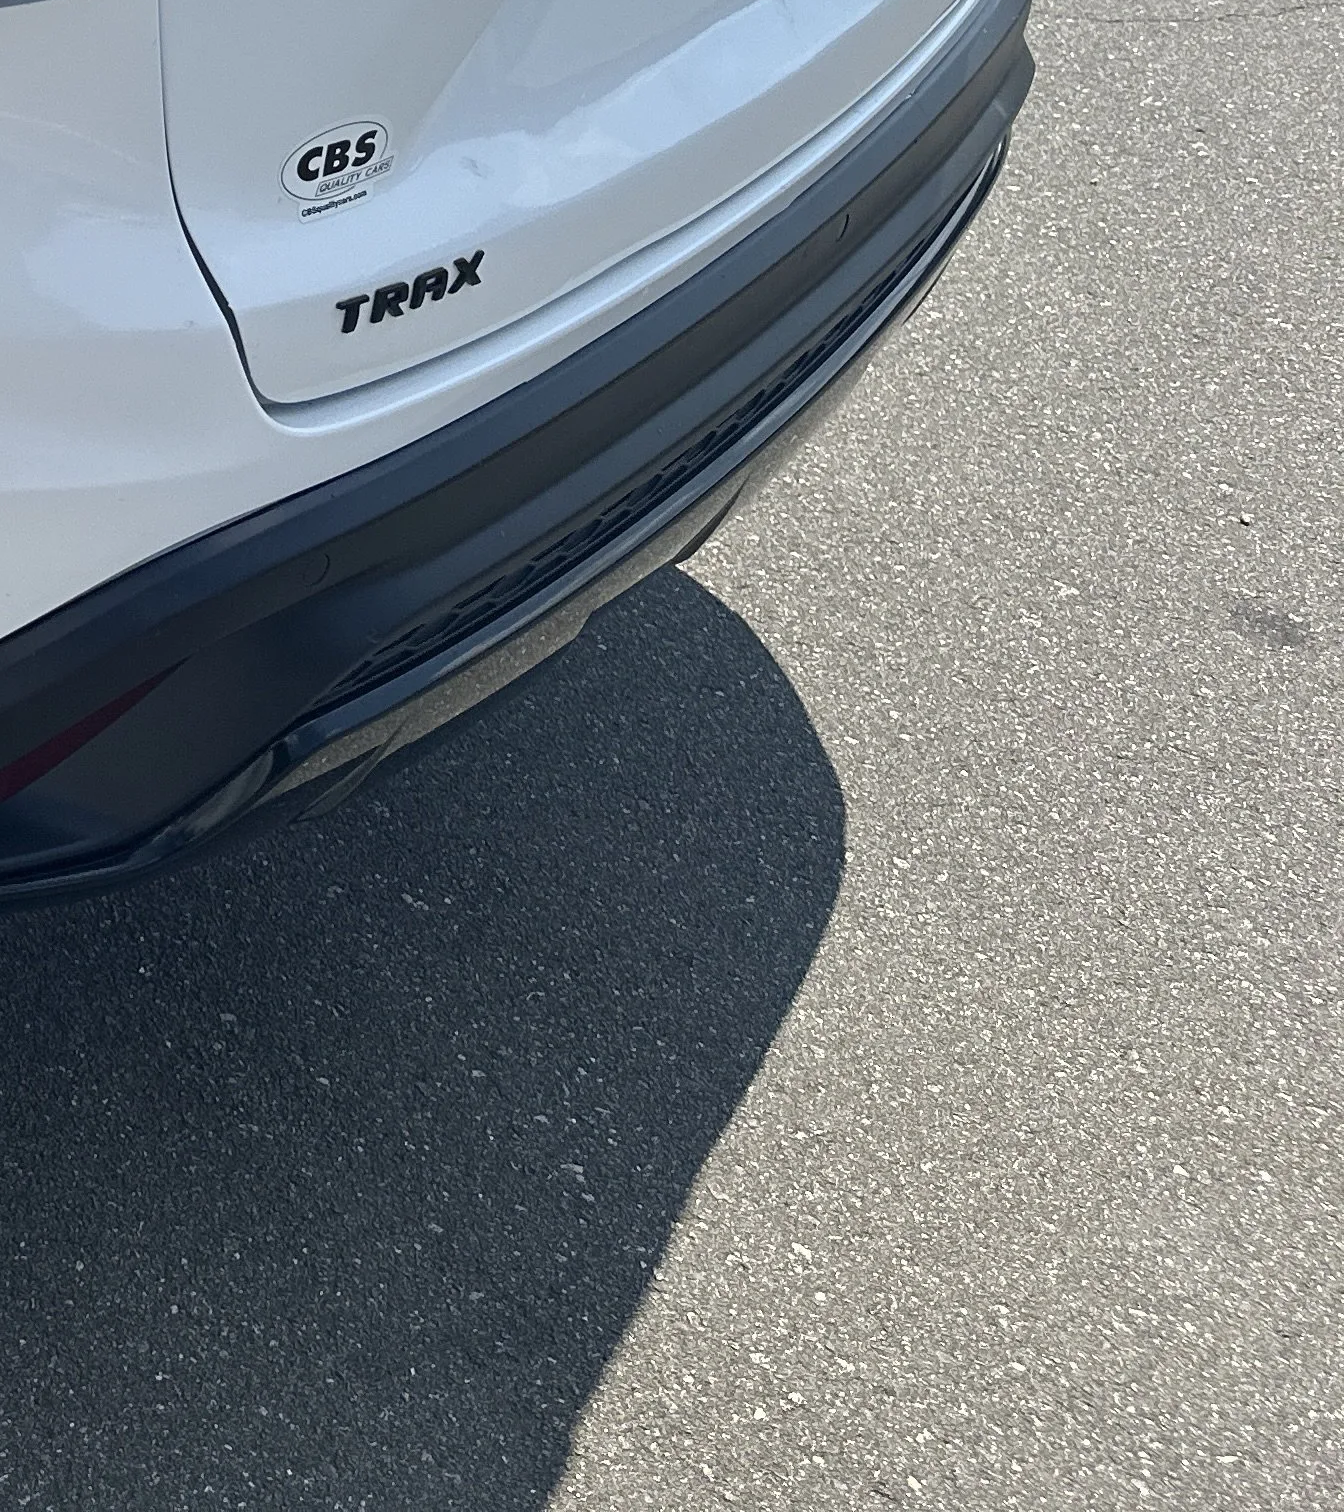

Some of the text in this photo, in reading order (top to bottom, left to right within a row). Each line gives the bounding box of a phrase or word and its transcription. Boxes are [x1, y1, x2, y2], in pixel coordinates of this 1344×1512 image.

[296, 129, 378, 182] CBS
[319, 159, 391, 193] QUALITY CARS
[335, 249, 485, 334] TRAX
